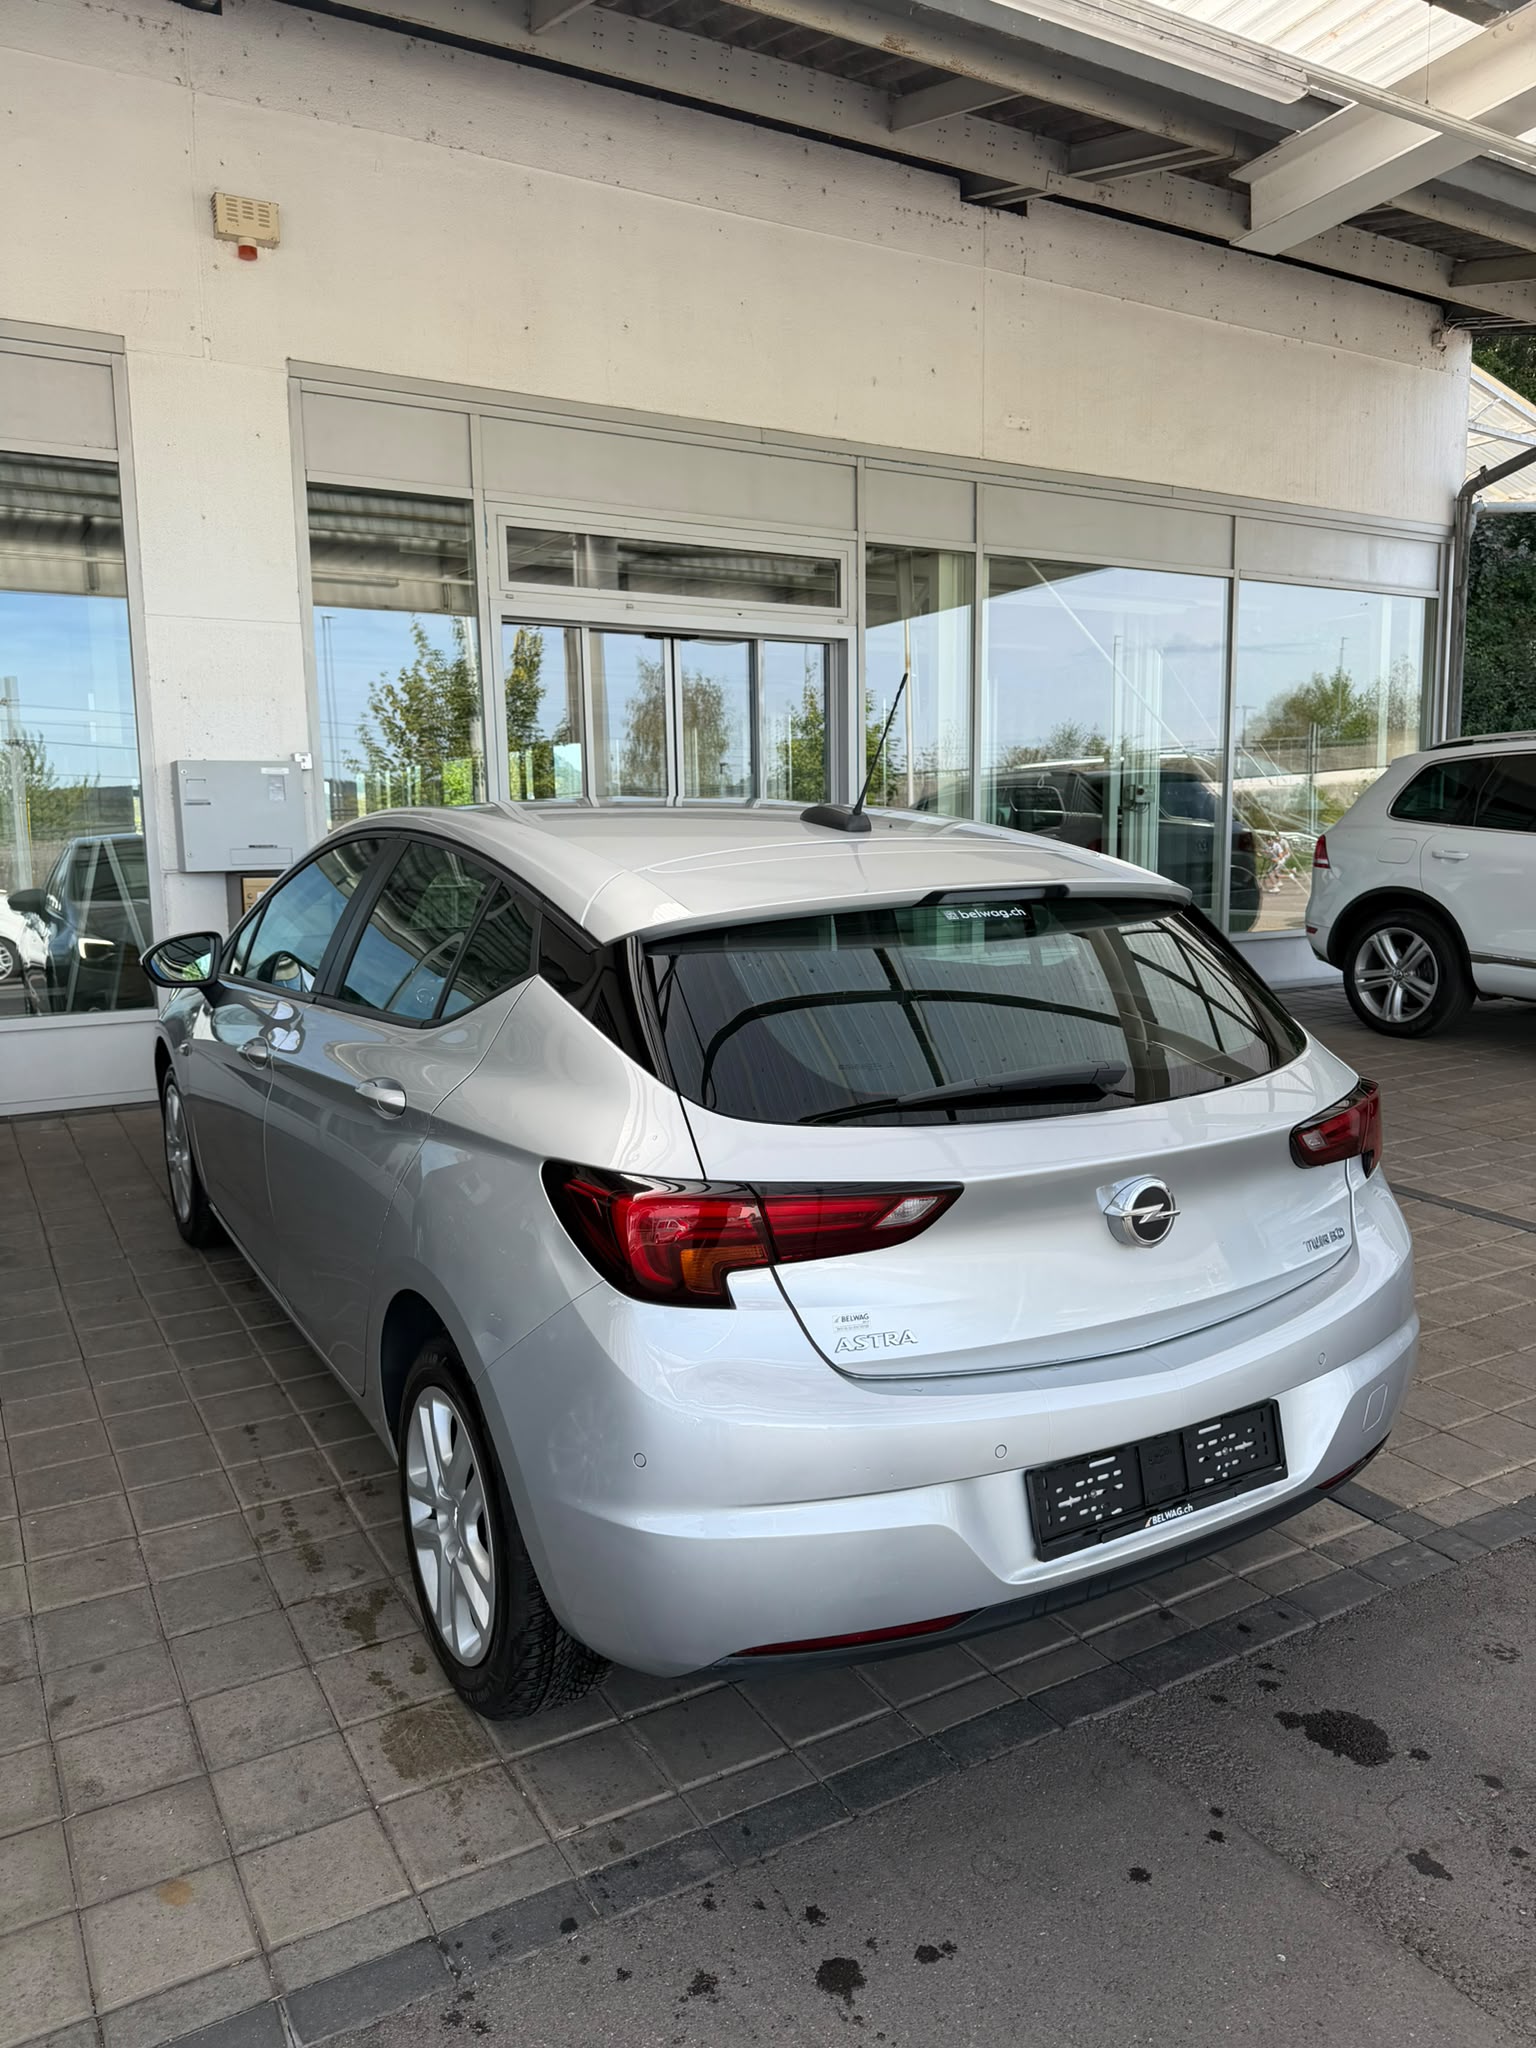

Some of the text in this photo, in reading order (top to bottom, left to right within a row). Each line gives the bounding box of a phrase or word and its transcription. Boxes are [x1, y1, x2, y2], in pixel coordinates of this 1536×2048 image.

[958, 907, 1027, 919] belwag.ch
[841, 1312, 870, 1323] BELWAG
[834, 1329, 919, 1354] ASTRA
[1152, 1503, 1194, 1525] BELWAG.ch
